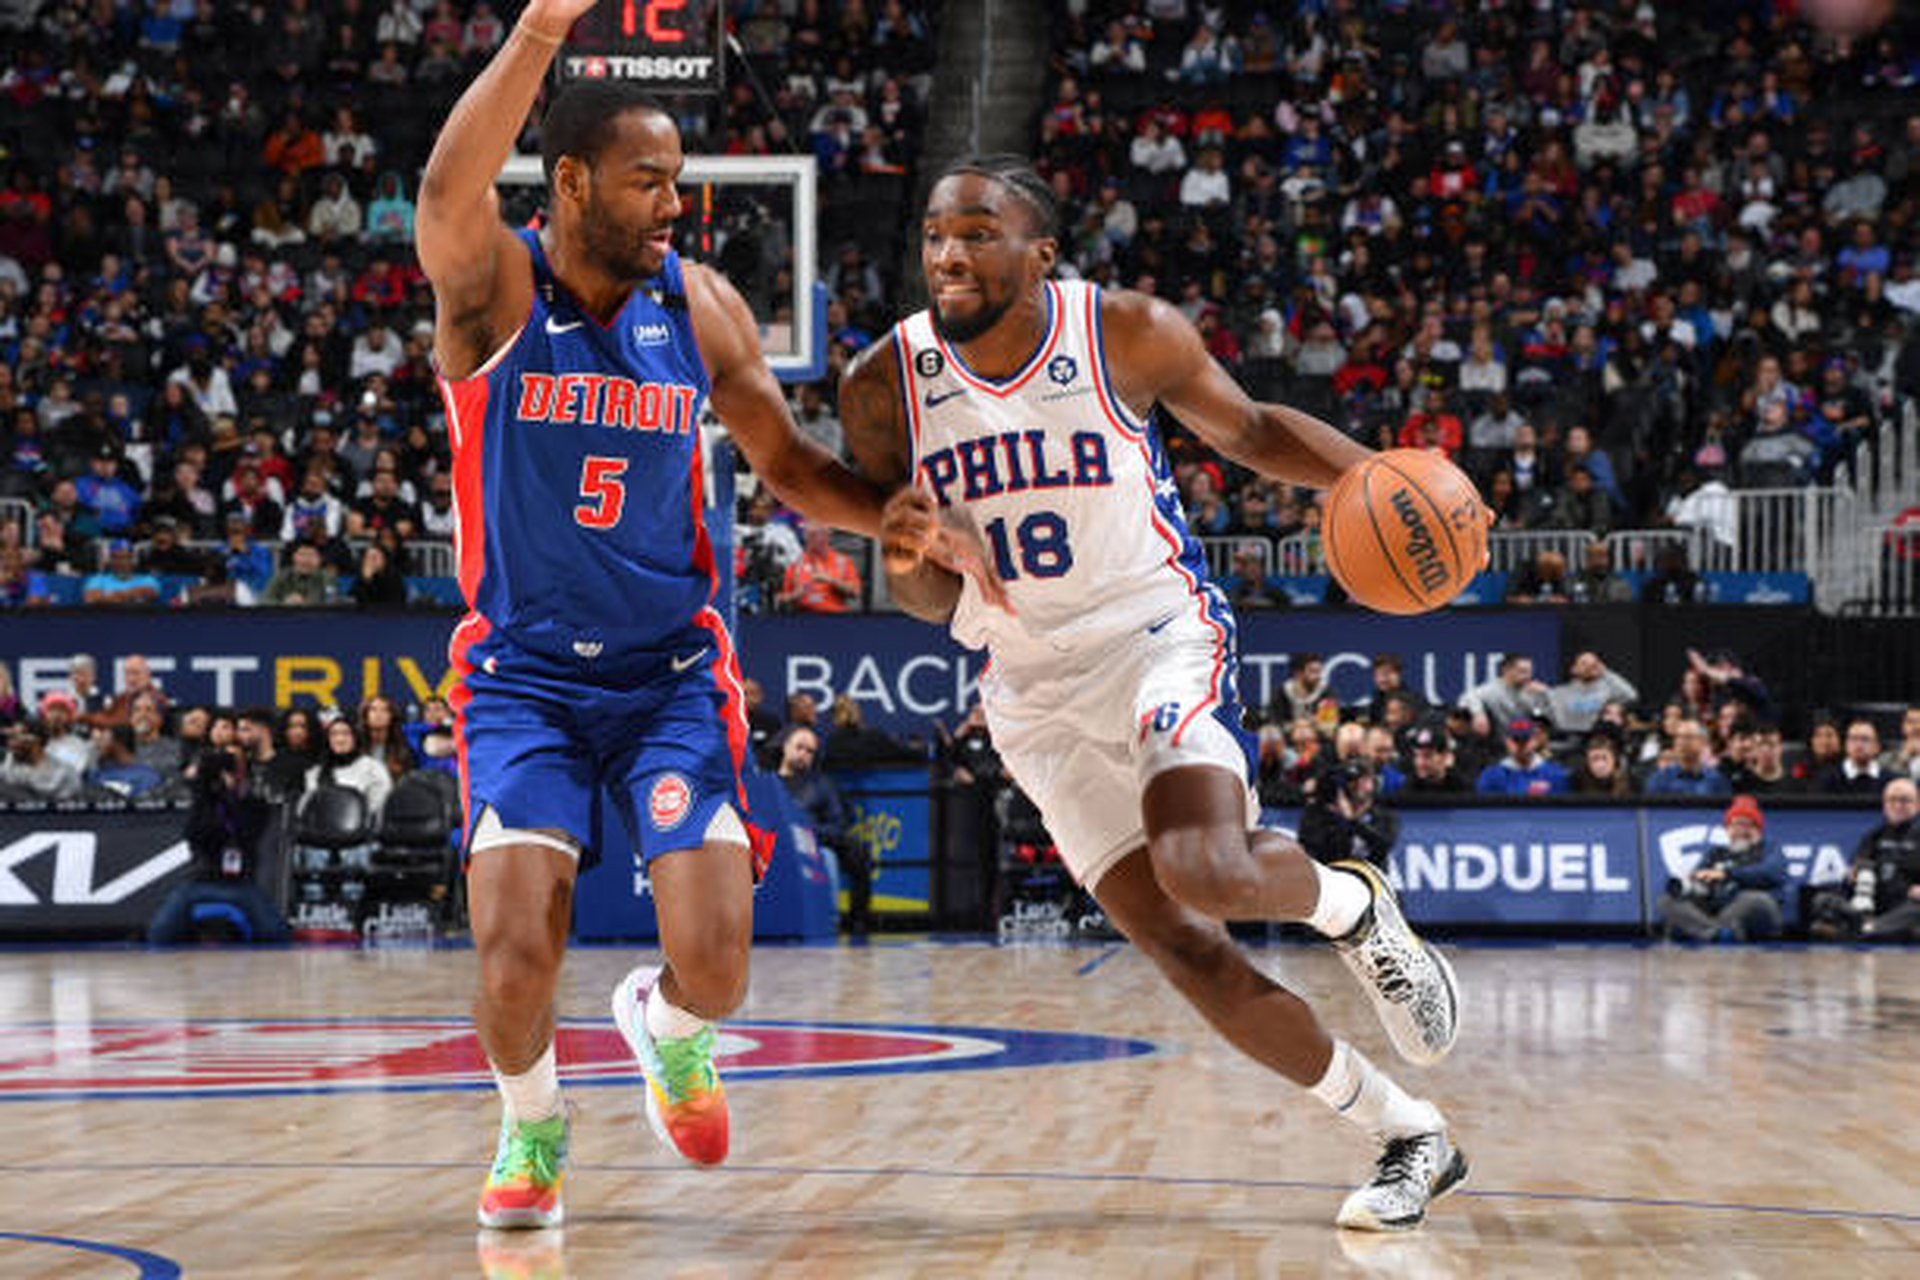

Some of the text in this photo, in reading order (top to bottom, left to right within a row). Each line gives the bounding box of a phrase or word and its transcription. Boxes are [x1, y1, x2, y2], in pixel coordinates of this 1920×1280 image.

[608, 57, 713, 78] TISSOT
[517, 372, 697, 434] DETROIT
[574, 455, 628, 528] 5
[921, 429, 1113, 507] PHILA
[985, 511, 1073, 581] 18
